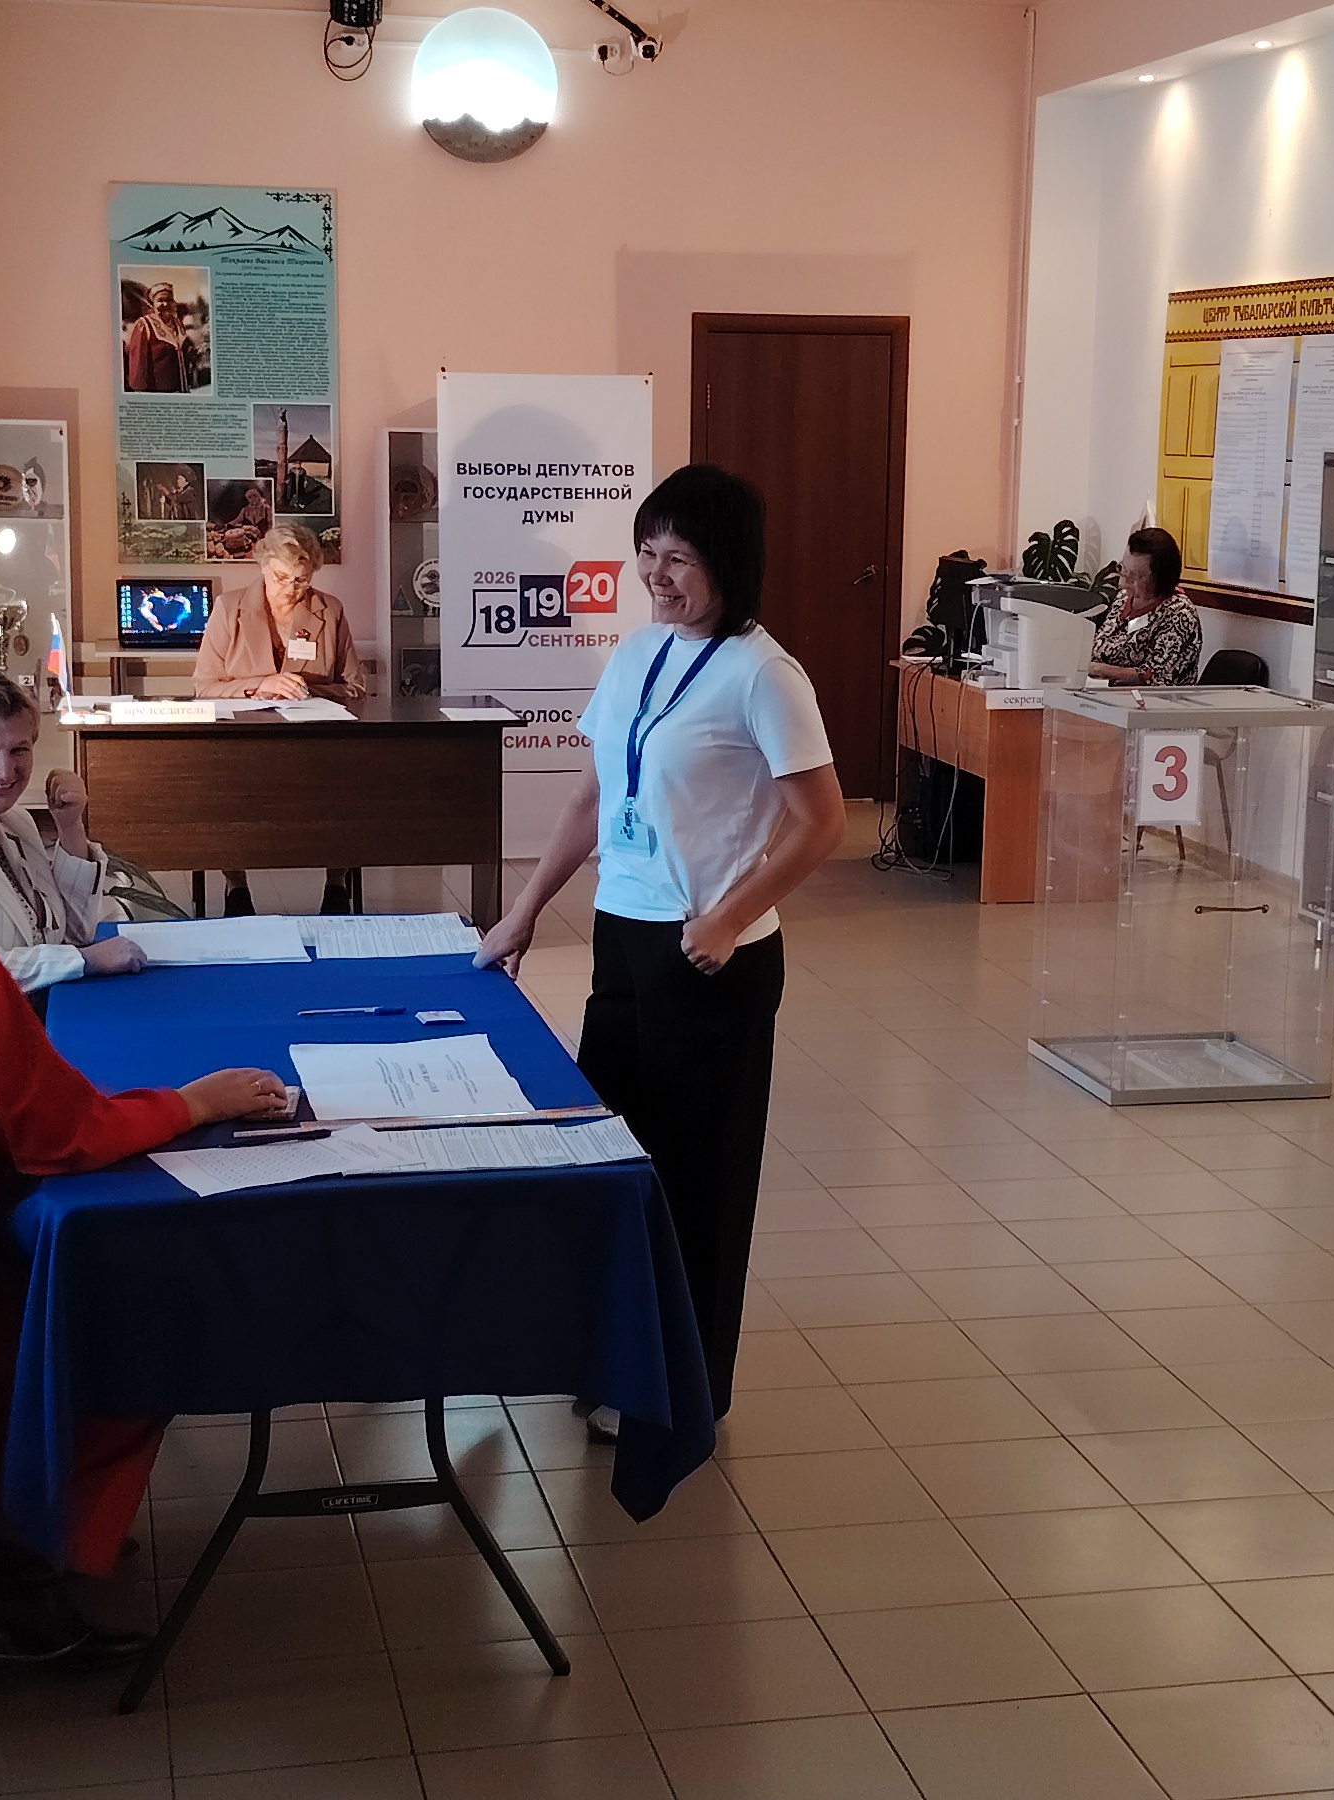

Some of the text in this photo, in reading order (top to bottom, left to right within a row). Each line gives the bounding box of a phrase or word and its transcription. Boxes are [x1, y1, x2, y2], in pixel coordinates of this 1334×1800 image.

[1203, 305, 1230, 326] ЦЕНТР
[1233, 294, 1297, 322] ТУБАЛАРСКОЙ
[456, 462, 635, 478] ВЫБОРЫ ДЕПУТАТОВ
[463, 484, 632, 501] ГОСУДАРСТВЕННОЙ
[521, 510, 574, 524] ДУМЫ
[473, 571, 516, 585] 2026
[569, 572, 615, 603] 20
[523, 587, 562, 618] 19
[479, 604, 516, 634] 18
[528, 633, 620, 648] СЕНТЯБРЯ
[23, 676, 30, 685] 2
[125, 706, 207, 717] председатель
[503, 735, 552, 748] СИЛА
[1152, 745, 1188, 802] 3
